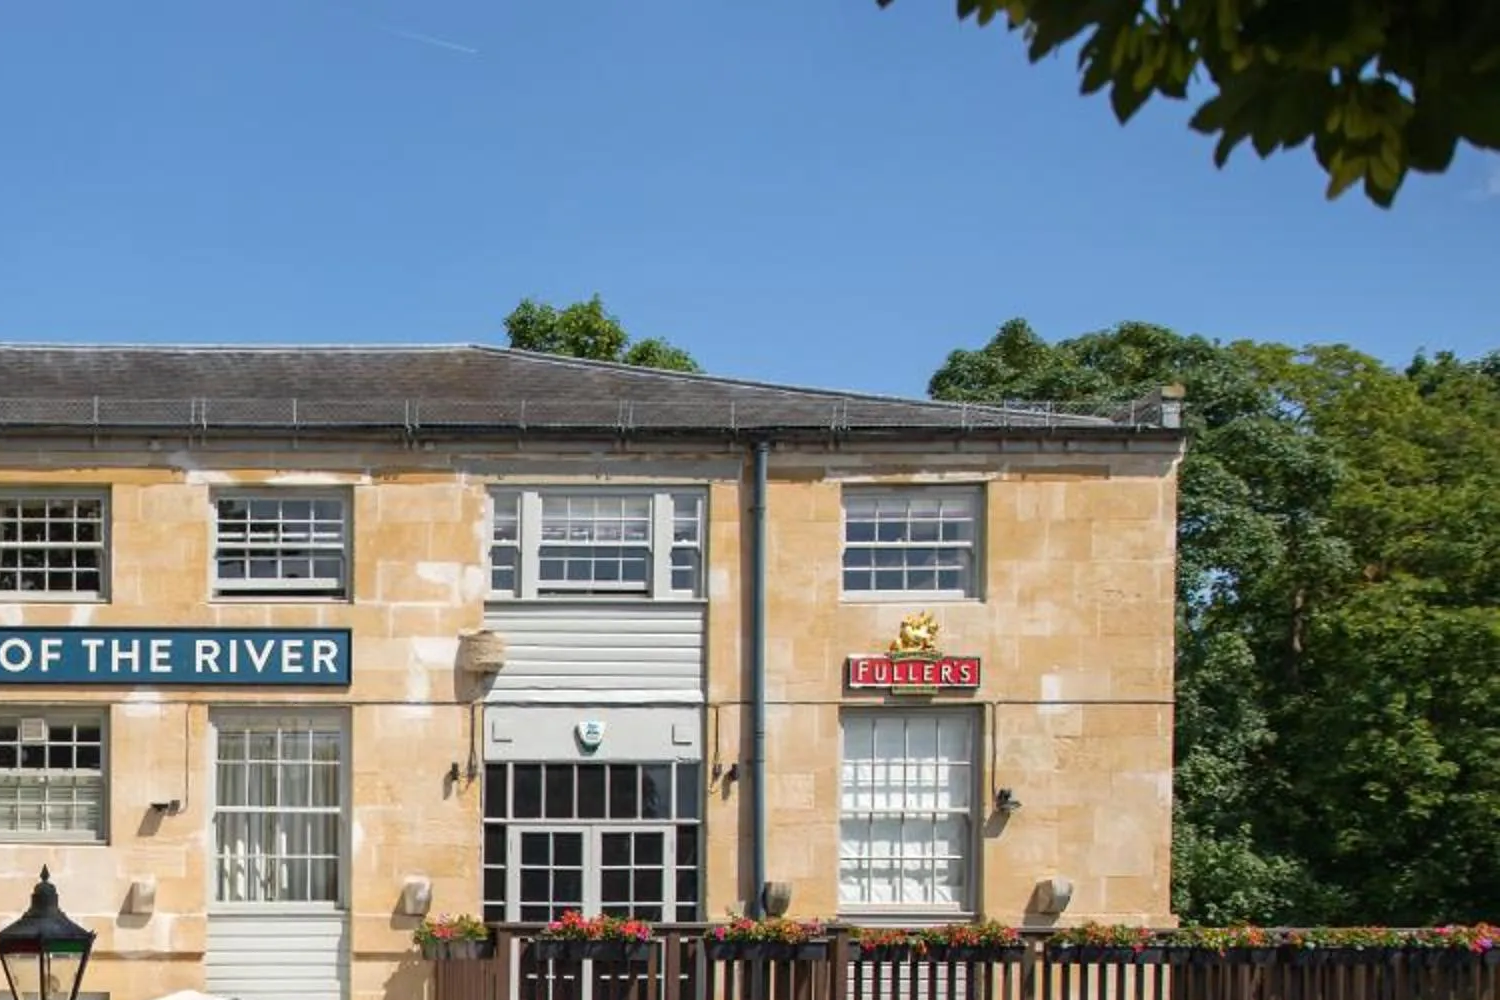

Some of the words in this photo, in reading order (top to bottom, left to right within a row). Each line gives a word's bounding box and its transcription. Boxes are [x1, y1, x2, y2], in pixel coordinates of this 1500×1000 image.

[81, 638, 173, 673] THE
[194, 639, 339, 673] RIVER
[857, 660, 971, 683] FULLER'S
